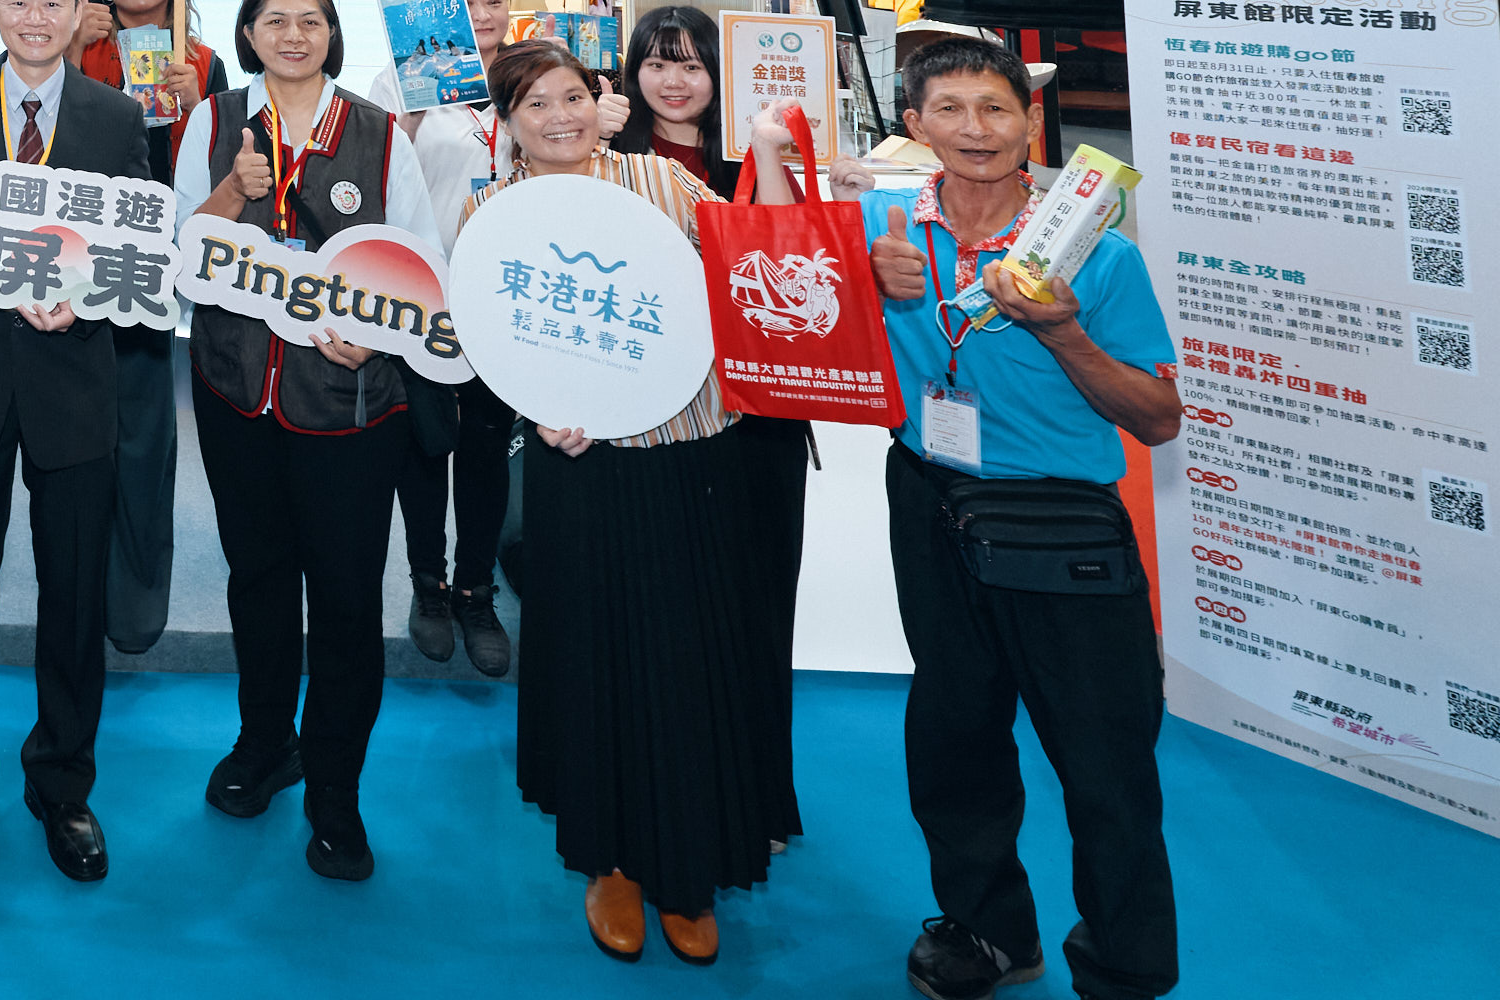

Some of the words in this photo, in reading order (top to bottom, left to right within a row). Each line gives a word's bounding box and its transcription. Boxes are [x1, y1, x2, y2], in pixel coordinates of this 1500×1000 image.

[1173, 0, 1437, 31] 屏東館限定活動
[1164, 37, 1356, 63] 恆春旅遊購go節
[751, 63, 807, 83] 金鑰獎
[751, 82, 807, 98] 友善旅宿
[1169, 131, 1355, 165] 優質民宿看這邊
[1031, 201, 1072, 254] 印加果油
[1177, 250, 1307, 285] 屏東全攻略
[195, 234, 464, 359] Pingtung
[495, 259, 664, 336] 東港味益
[510, 308, 645, 361] 鬆品專賣店
[723, 357, 884, 384] 屏東縣大鵬灣觀光產業聯盟
[725, 371, 759, 384] DAPENG
[760, 374, 778, 385] BAY
[778, 377, 812, 388] TRAVEL
[813, 380, 857, 392] INDUSTRY
[857, 384, 885, 393] ALLIES
[1183, 354, 1368, 406] 豪禮轟炸四重抽
[1184, 406, 1231, 426] 第一抽
[1188, 469, 1236, 489] 第二抽
[1293, 689, 1373, 725] 屏東縣政府
[1332, 715, 1397, 746] 希望城市
